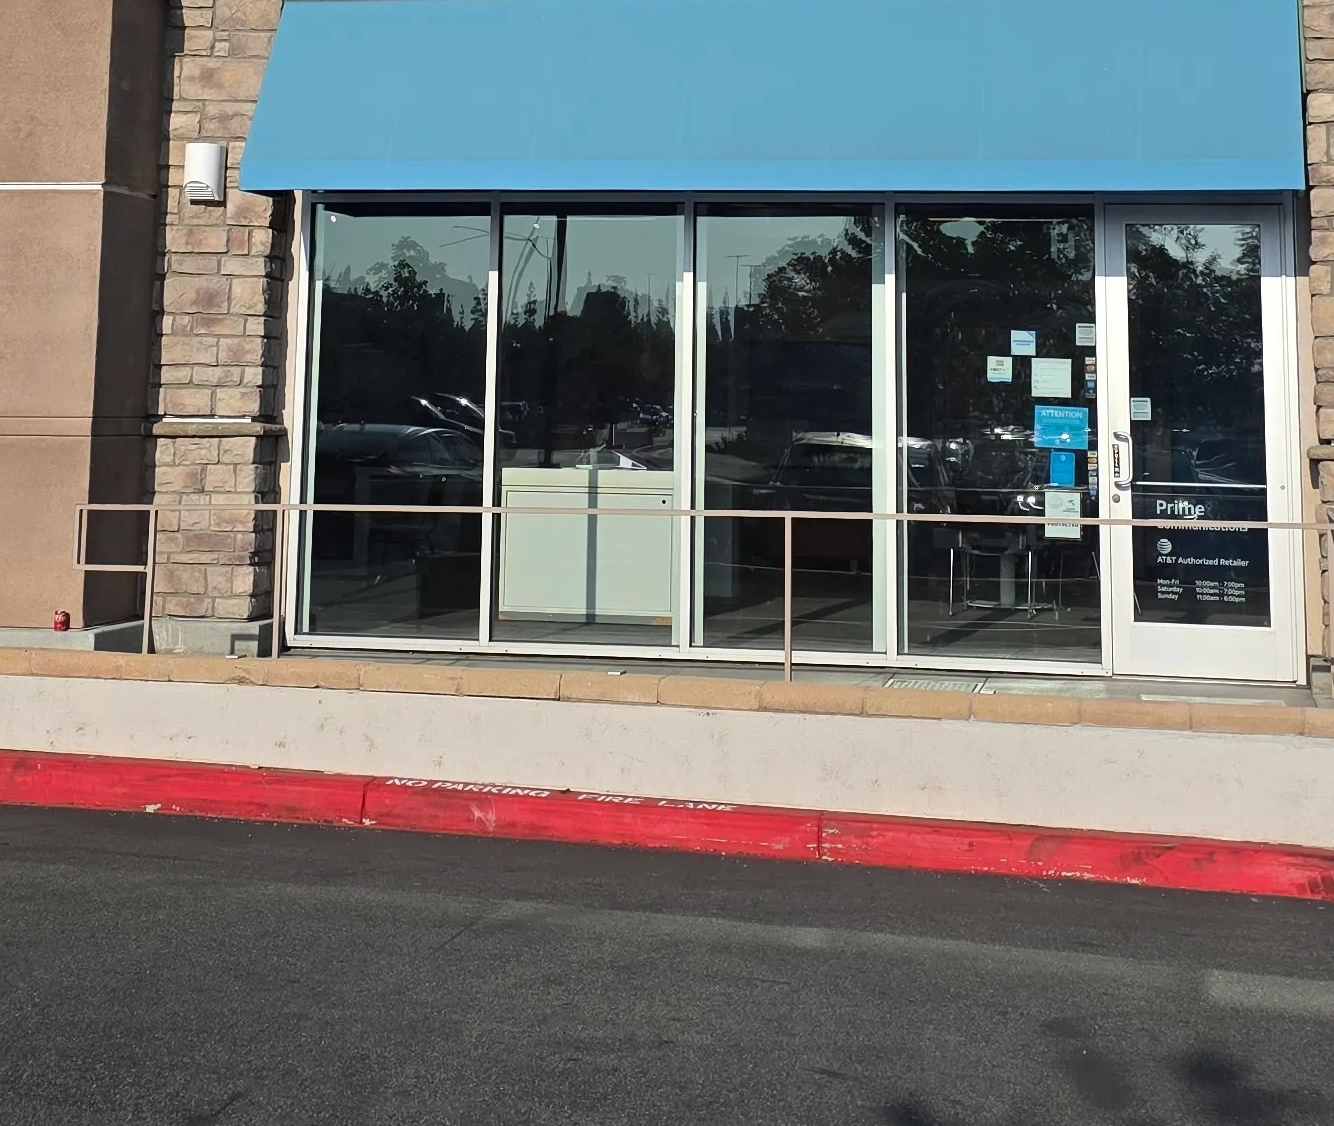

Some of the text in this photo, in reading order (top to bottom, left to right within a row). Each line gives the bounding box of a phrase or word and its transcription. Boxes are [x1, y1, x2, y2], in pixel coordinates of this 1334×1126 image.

[1040, 410, 1083, 418] ATTENTION
[1156, 499, 1205, 516] Prime
[1157, 556, 1249, 567] AT&T Authorized Retailer
[385, 777, 738, 812] NO PARKING FIRE LANE
